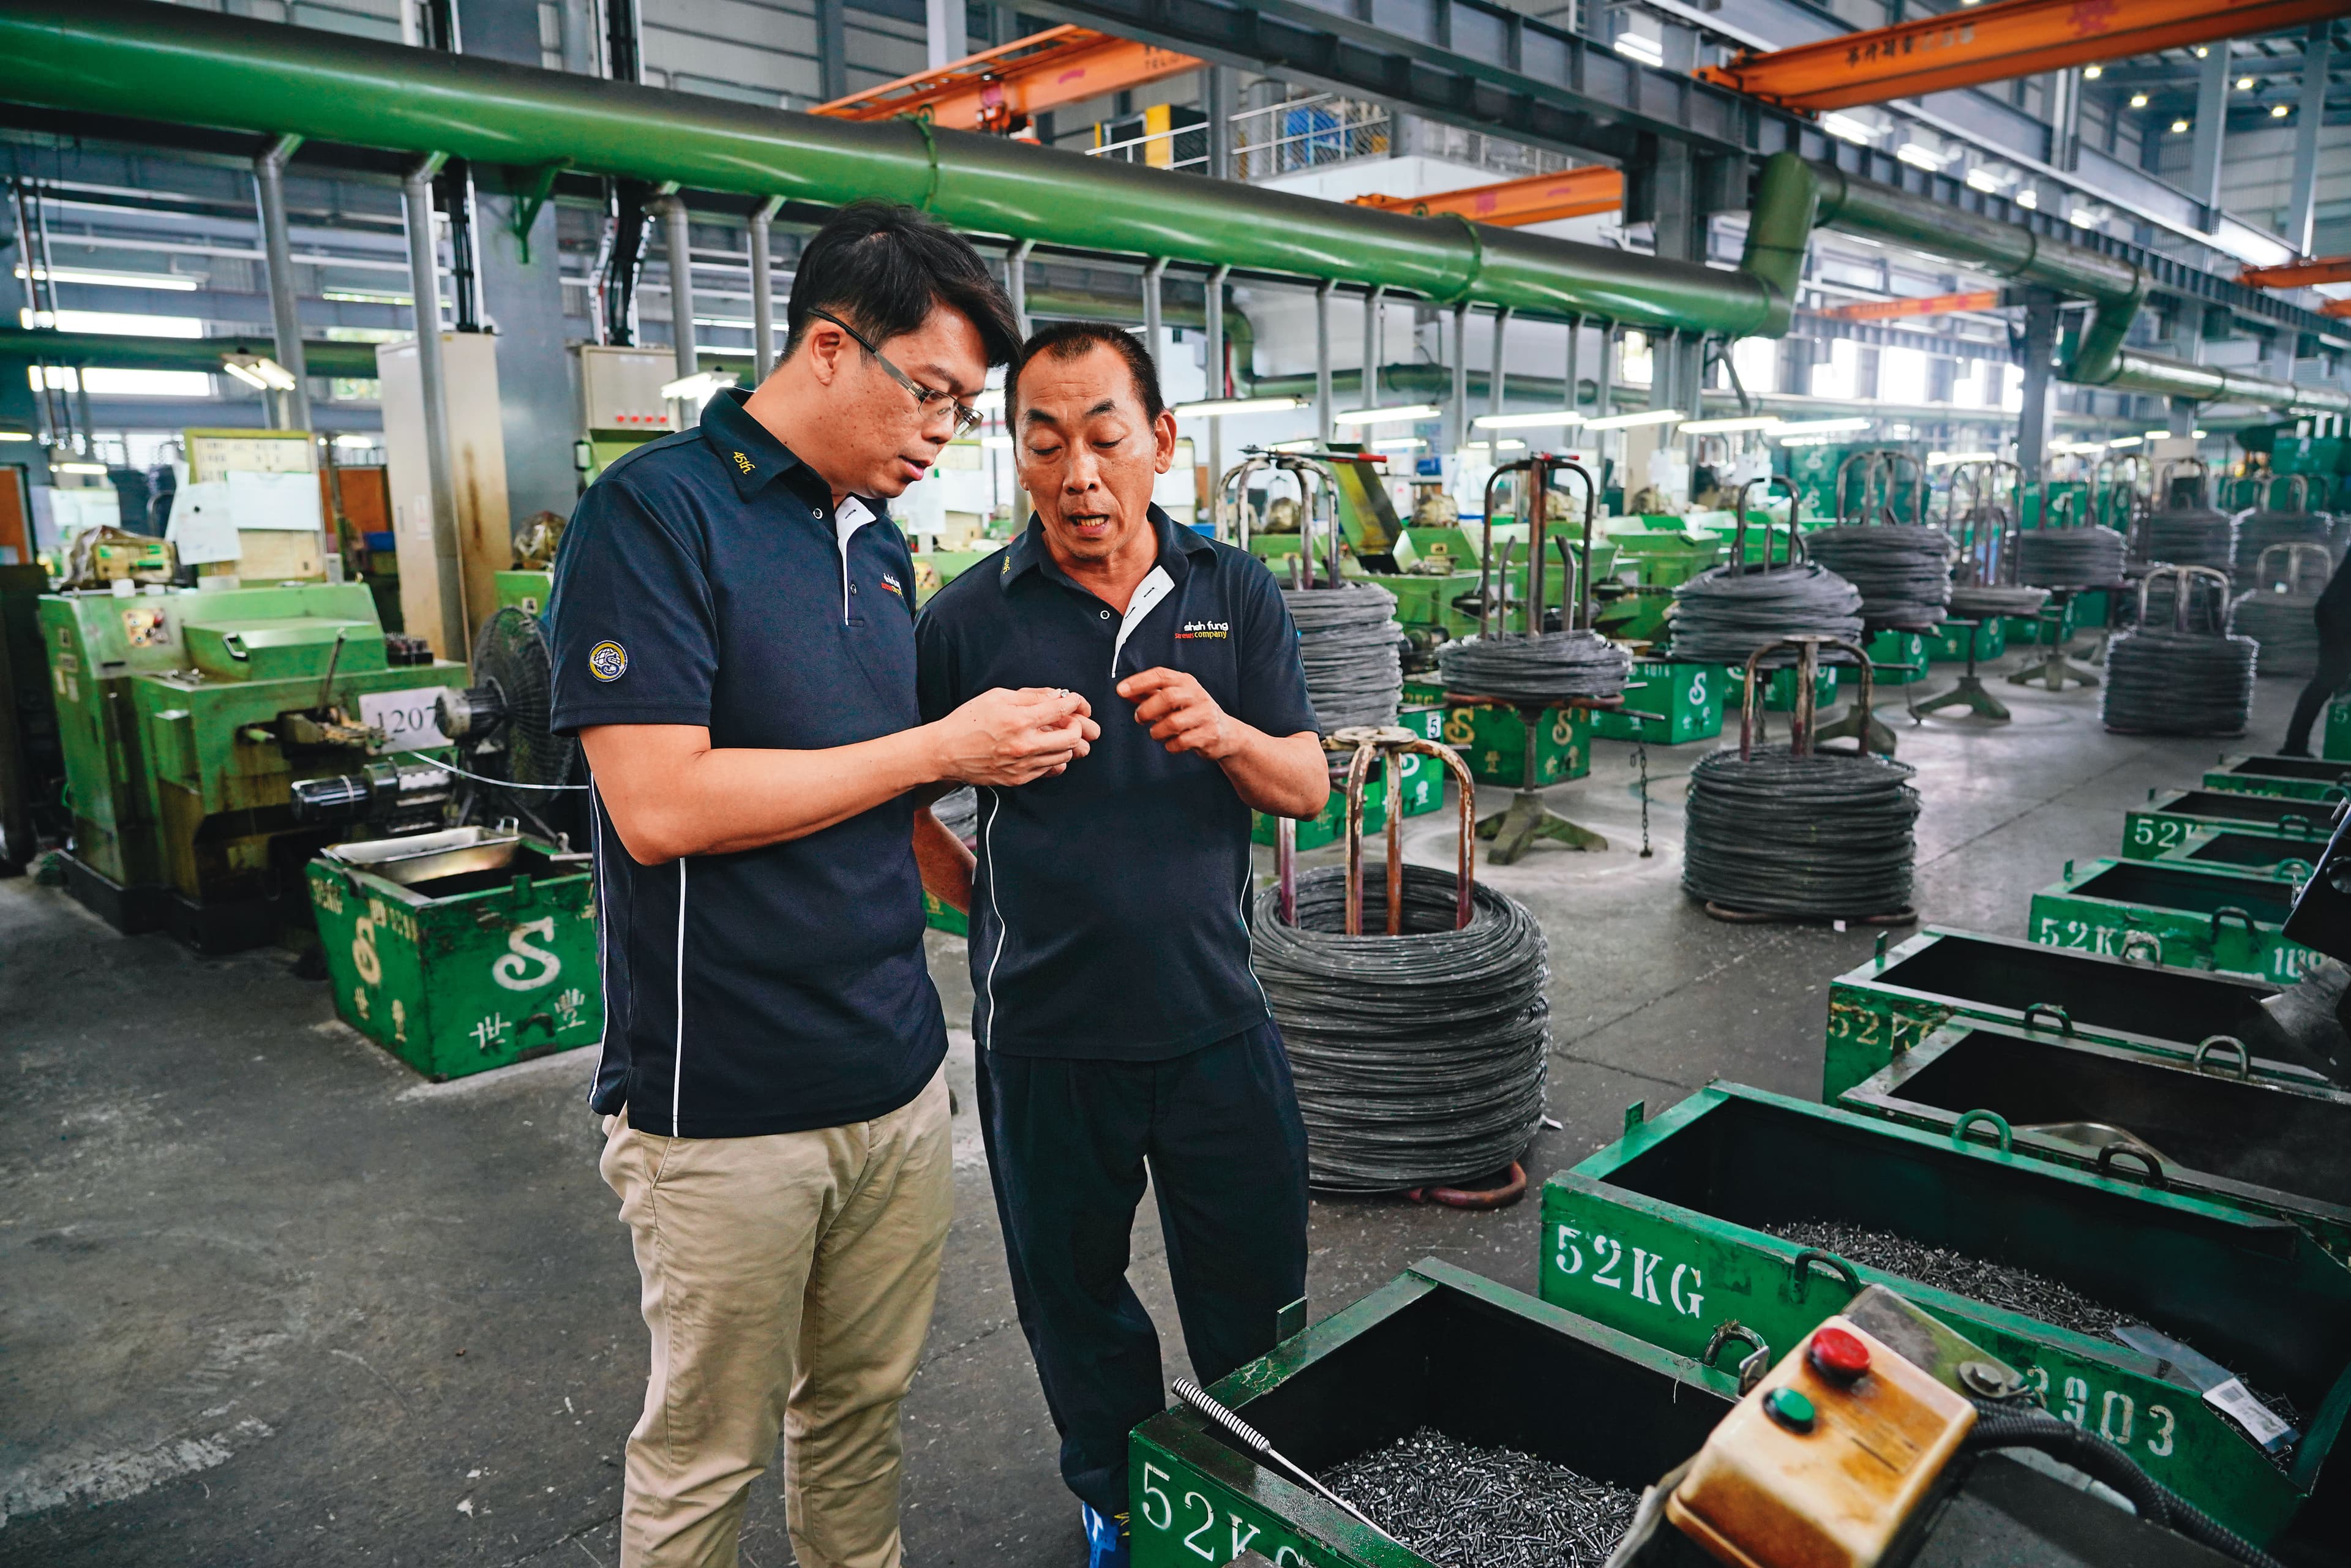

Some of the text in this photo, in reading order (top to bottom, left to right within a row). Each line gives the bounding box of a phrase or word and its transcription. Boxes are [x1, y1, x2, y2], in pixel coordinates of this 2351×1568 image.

[733, 451, 756, 475] 45th
[1207, 620, 1229, 631] fung
[1430, 718, 1438, 736] 5
[1444, 708, 1475, 743] S
[492, 916, 561, 992] S
[1556, 1224, 1704, 1319] 52KG
